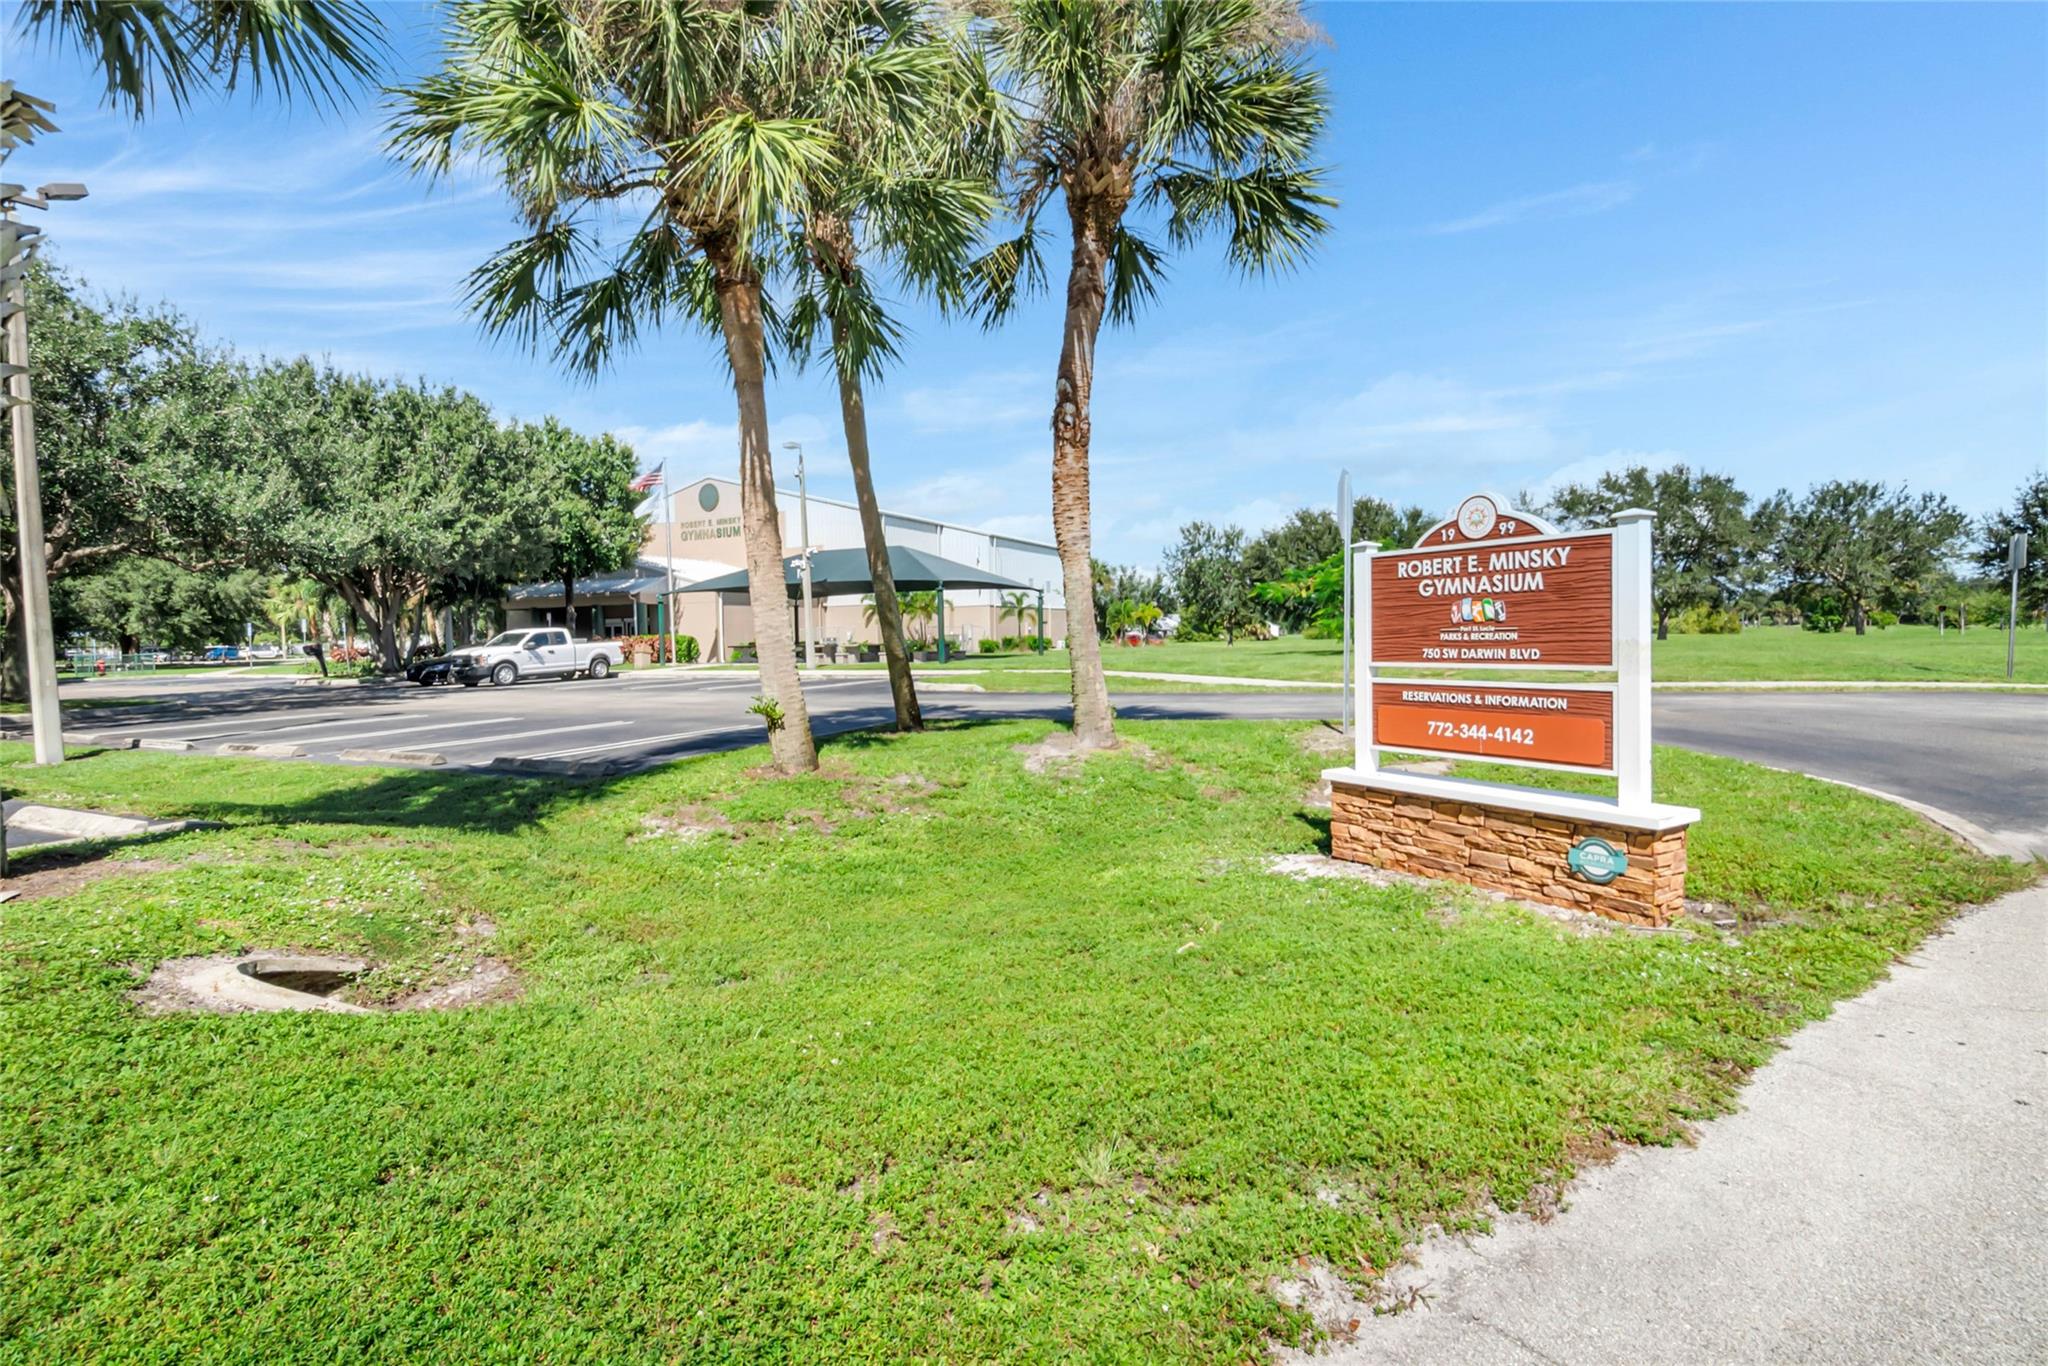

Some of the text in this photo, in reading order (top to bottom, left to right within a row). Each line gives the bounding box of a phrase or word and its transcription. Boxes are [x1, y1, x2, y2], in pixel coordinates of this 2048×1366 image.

[681, 520, 705, 529] ROBERT
[716, 517, 741, 525] MINSKY
[1440, 521, 1516, 542] 19 99
[681, 526, 741, 541] GYMNASIUM
[1398, 546, 1571, 579] ROBERT E. MINSKY
[1418, 572, 1544, 597] GYMNASIUM
[1440, 632, 1518, 641] PARKS & RECREATION
[1423, 648, 1540, 660] 750 SW DARWIN BLVD
[1402, 691, 1568, 709] RESERVATIONS & INFORMATION
[1428, 721, 1534, 745] 772-344-4142
